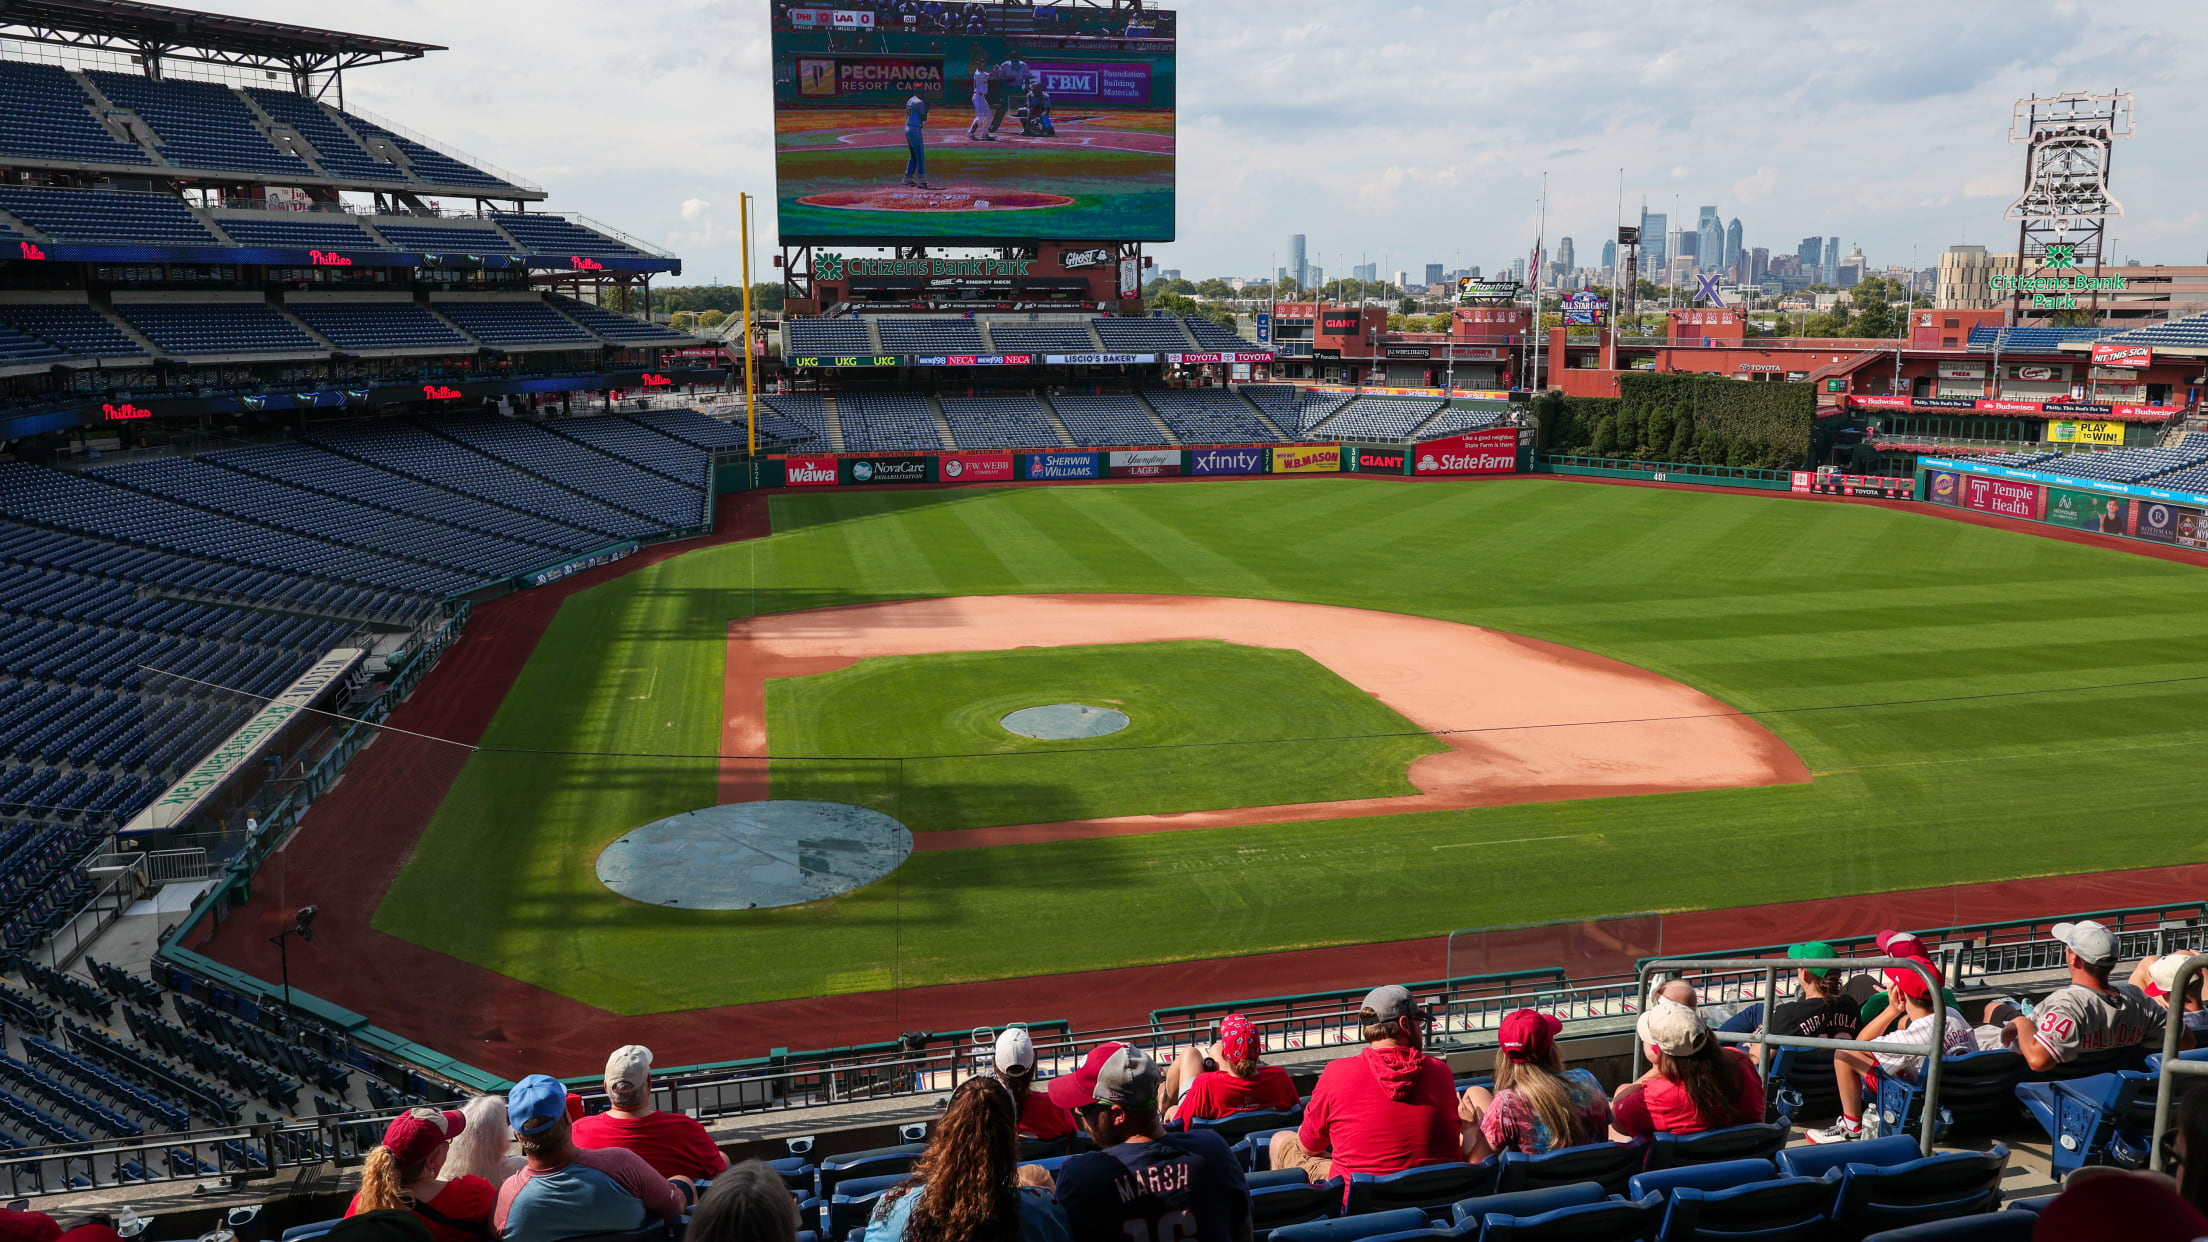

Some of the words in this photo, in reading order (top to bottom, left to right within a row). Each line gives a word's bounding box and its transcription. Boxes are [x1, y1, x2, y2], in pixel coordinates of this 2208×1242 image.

[820, 13, 829, 22] 0
[861, 14, 870, 24] 0
[841, 65, 940, 80] PECHANGA
[1104, 70, 1146, 78] Foundation
[842, 82, 890, 90] RESORT
[1046, 74, 1090, 90] FBM
[1104, 80, 1135, 88] Building
[1104, 89, 1139, 97] Materials
[310, 250, 352, 266] Phillies
[571, 256, 602, 270] Phillies
[1065, 249, 1099, 268] GHOST
[848, 258, 928, 276] Citizens
[932, 257, 982, 276] Bank
[986, 257, 1029, 276] Park
[1464, 279, 1514, 291] Fitzpatrick
[1990, 275, 2070, 290] Citizens
[2074, 273, 2127, 290] Bank
[2032, 293, 2077, 309] Park
[1279, 306, 1286, 314] P
[1306, 306, 1312, 314] P
[948, 356, 974, 365] NECA
[1006, 356, 1030, 364] NECA
[1238, 353, 1271, 361] TOYOTA
[2094, 353, 2108, 361] HIT
[2109, 350, 2126, 361] THIS
[2128, 348, 2148, 357] SIGN
[796, 358, 818, 366] UKG
[835, 358, 857, 366] UKG
[874, 357, 895, 365] UKG
[642, 374, 671, 386] Phillies
[424, 385, 461, 400] Phillies
[103, 403, 151, 420] Phillies
[2081, 424, 2107, 432] PLAY
[1046, 456, 1090, 466] SHERWIN
[1123, 453, 1168, 465] Yuengling
[1196, 452, 1257, 471] xfinity
[1360, 456, 1403, 468] GIANT
[873, 462, 924, 473] NovaCare
[983, 462, 1008, 470] WEBB
[1131, 466, 1160, 475] LAGER
[788, 467, 835, 482] Wawa
[1654, 473, 1666, 481] 401
[1993, 482, 2032, 500] Temple
[1992, 498, 2028, 515] Health
[2155, 512, 2162, 520] R
[2141, 526, 2173, 536] ROTHMAN
[538, 575, 546, 584] 10
[279, 660, 348, 703] WELCOME
[224, 714, 286, 754] Citizens
[194, 751, 245, 779] Bank
[158, 779, 217, 806] Park
[2041, 1012, 2072, 1040] 34
[1114, 1163, 1189, 1204] MARSH
